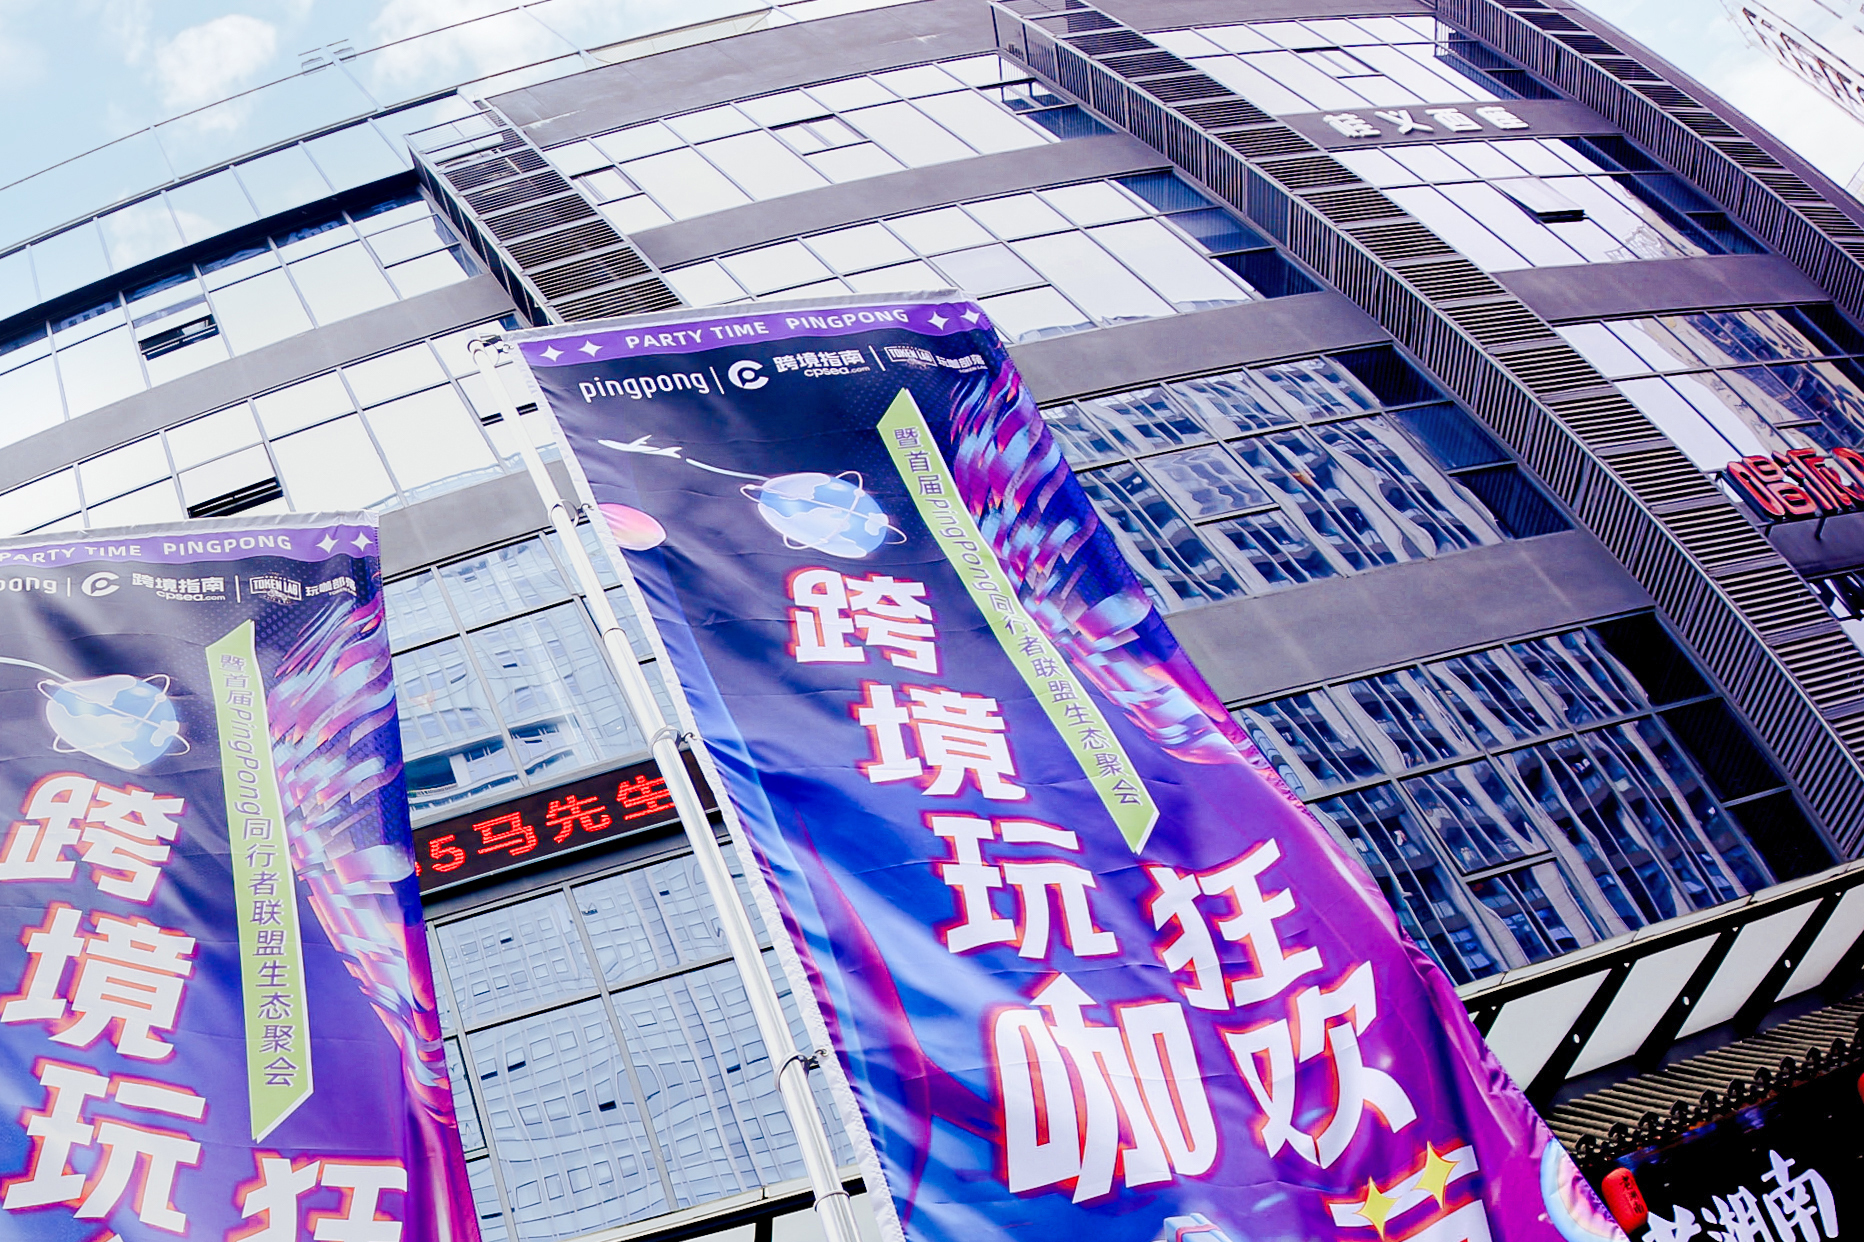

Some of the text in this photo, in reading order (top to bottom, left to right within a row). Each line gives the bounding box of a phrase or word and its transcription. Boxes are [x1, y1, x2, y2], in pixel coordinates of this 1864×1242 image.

[624, 308, 910, 350] PARTY TIME PINGPONG
[772, 349, 866, 374] 跨境指南
[578, 371, 711, 403] pingpong
[83, 544, 142, 557] TIME
[163, 535, 293, 557] PINGPONG
[131, 572, 225, 593] 跨境指南
[415, 773, 678, 877] 5马先生
[790, 569, 1220, 1205] 跨境玩咖
